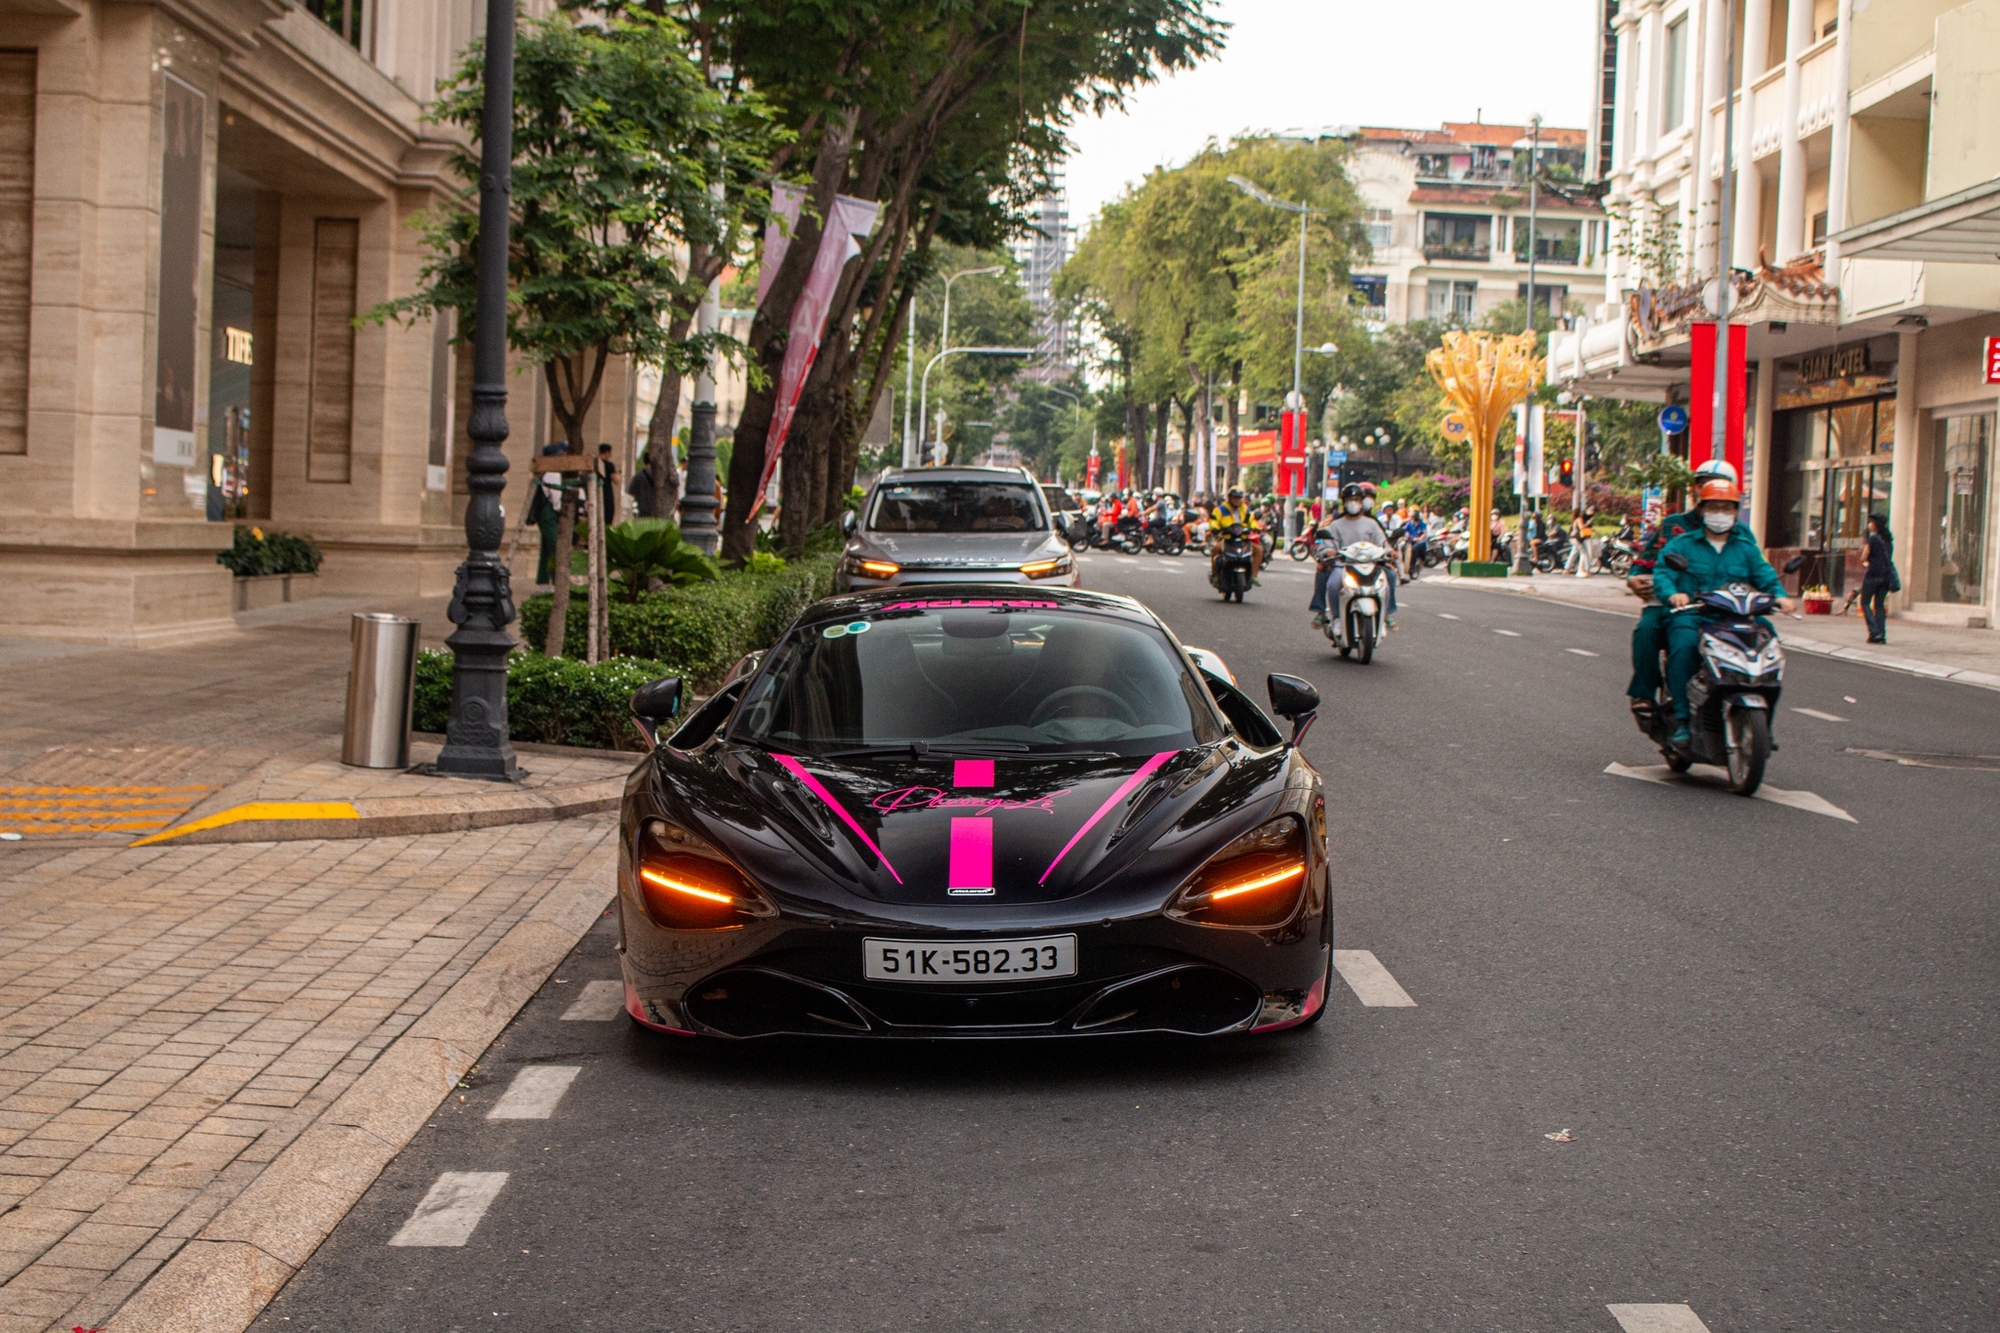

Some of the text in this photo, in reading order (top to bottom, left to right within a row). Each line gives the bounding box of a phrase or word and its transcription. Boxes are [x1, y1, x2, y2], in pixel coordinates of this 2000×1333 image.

[1831, 347, 1866, 380] HOTEL
[1446, 419, 1465, 433] be
[882, 945, 1058, 975] 51K-582.33
